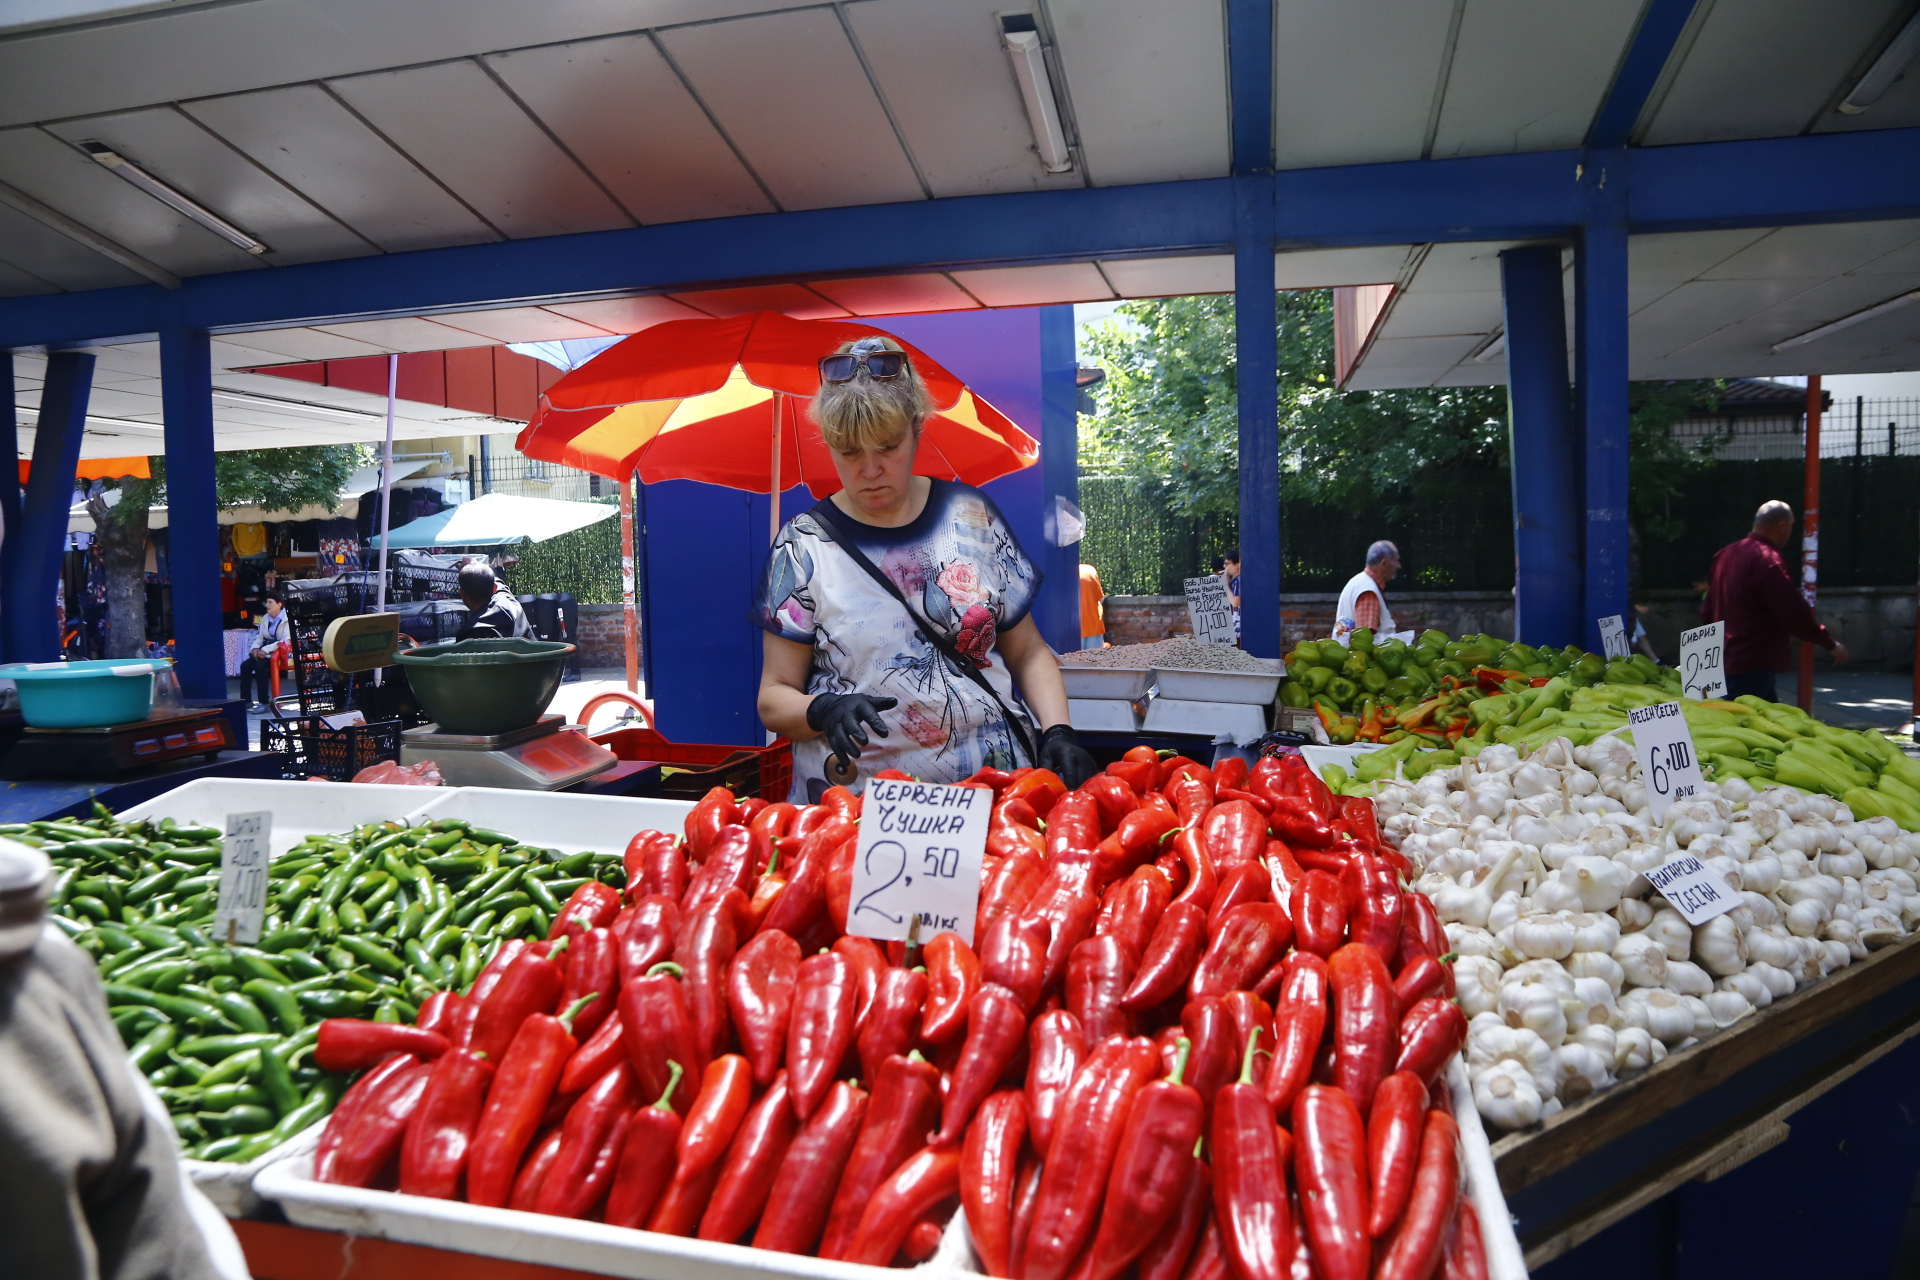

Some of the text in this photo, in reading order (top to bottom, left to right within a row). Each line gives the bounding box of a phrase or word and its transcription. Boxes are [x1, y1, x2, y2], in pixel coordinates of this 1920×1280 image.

[1681, 625, 1716, 647] СИВРИЯ
[1684, 646, 1720, 694] 2,50
[871, 780, 976, 809] ЧЕРВЕНА
[878, 804, 964, 834] ЧУШКА
[854, 840, 960, 924] 2,50
[1645, 857, 1704, 889] БЪЛГАРСКИ
[1666, 882, 1721, 915] ЧЕСЪН
